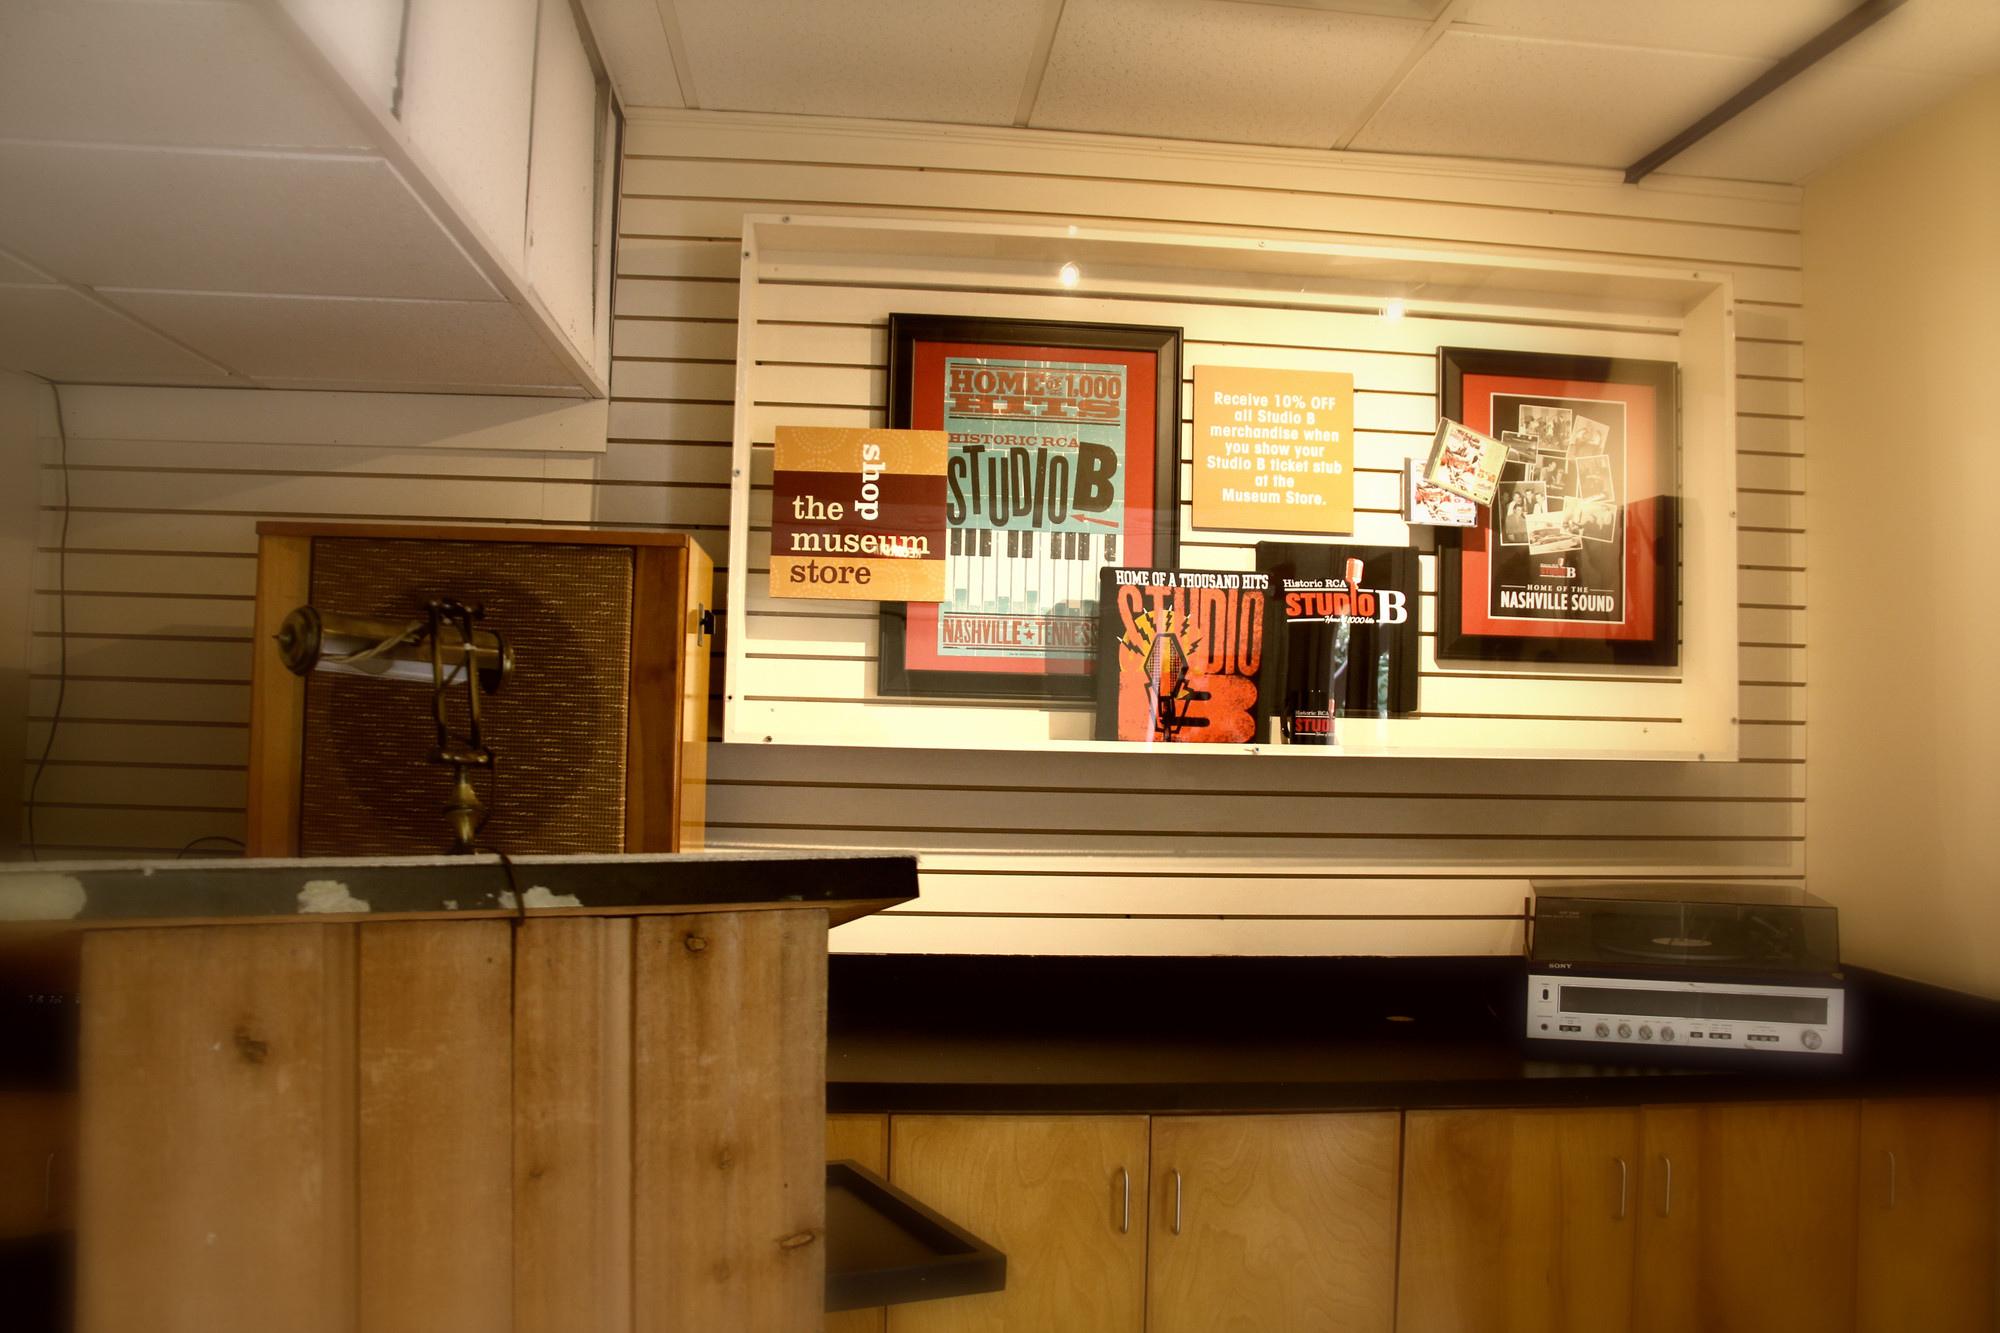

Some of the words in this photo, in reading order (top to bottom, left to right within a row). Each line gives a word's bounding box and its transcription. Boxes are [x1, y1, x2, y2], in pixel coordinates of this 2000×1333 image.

[950, 369, 1045, 395] HOME
[1066, 374, 1122, 399] 1,000
[949, 394, 1121, 418] HITS
[1214, 391, 1268, 406] Receive
[1274, 394, 1306, 409] 10%
[1311, 396, 1336, 410] OFF
[1234, 409, 1252, 422] all
[1258, 409, 1301, 424] Studio
[1306, 412, 1316, 425] B
[948, 433, 1037, 446] HISTORIC
[1041, 436, 1080, 448] RCA
[1210, 425, 1299, 440] merchandise
[1304, 428, 1339, 442] when
[1225, 442, 1249, 456] you
[1254, 442, 1290, 456] show
[1294, 445, 1325, 459] your
[1207, 455, 1251, 470] Studio
[1257, 458, 1265, 470] B
[1270, 458, 1308, 472] ticket
[1313, 460, 1342, 474] stub
[854, 444, 886, 520] shop
[946, 445, 1069, 528] STUDIO
[1072, 441, 1118, 513] B
[1255, 475, 1268, 487] at
[1273, 474, 1295, 488] the
[1222, 488, 1280, 503] Museum
[1286, 491, 1327, 505] Store.
[792, 495, 844, 520] the
[790, 532, 930, 555] museum
[790, 559, 871, 584] store
[1115, 570, 1150, 586] HOME
[1152, 572, 1168, 587] OF
[1168, 572, 1177, 587] A
[1179, 573, 1240, 589] THOUSAND
[1242, 574, 1269, 589] HITS
[1283, 579, 1323, 588] Historic
[1325, 579, 1347, 588] RCA
[1527, 584, 1552, 592] HOME
[1285, 591, 1375, 617] STUDIO
[1375, 590, 1408, 624] B
[1501, 591, 1568, 611] NASHVILLE
[1571, 594, 1614, 613] SOUND
[943, 618, 1022, 645] NASHVILLE
[1117, 584, 1265, 676] STUDIO
